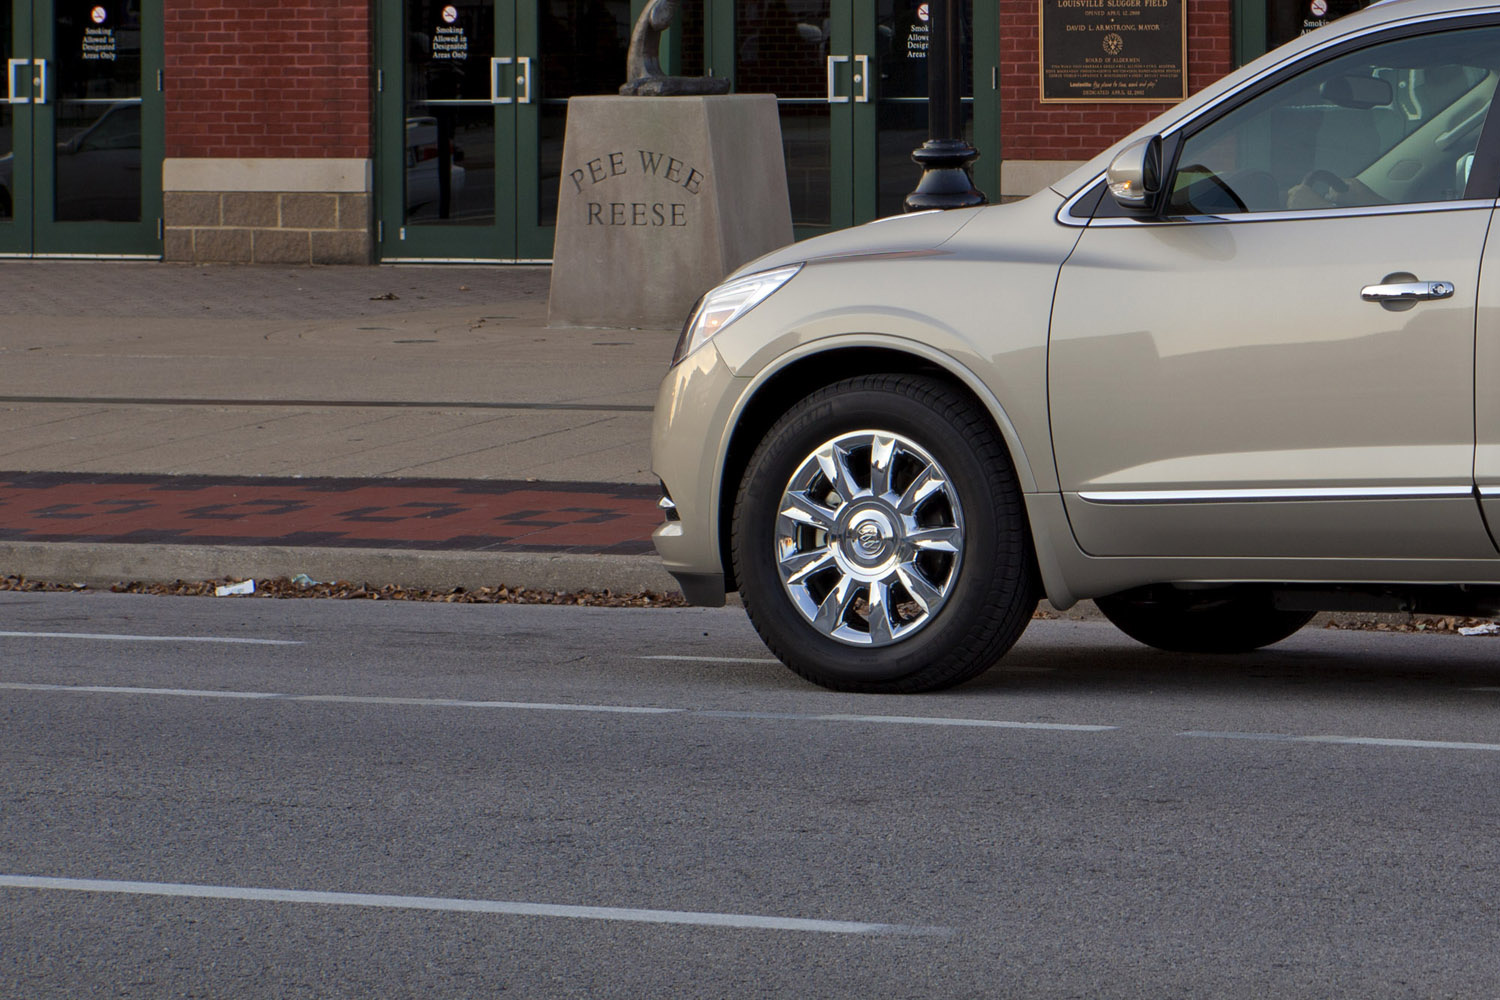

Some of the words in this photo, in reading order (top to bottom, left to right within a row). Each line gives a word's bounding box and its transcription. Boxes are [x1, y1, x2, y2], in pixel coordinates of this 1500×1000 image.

[1057, 0, 1104, 8] LOUISVILLE
[1107, 0, 1141, 7] SLUGGER
[1144, 0, 1168, 7] FIELD
[85, 27, 112, 36] Smoking
[435, 26, 464, 34] Smoking
[82, 43, 116, 52] Designated
[432, 43, 468, 51] Designated
[100, 51, 116, 61] Only
[432, 51, 451, 59] Areas
[452, 51, 467, 60] Only
[907, 50, 926, 58] Areas
[568, 151, 628, 194] PEE
[637, 149, 705, 195] WEE
[586, 202, 688, 227] REESE
